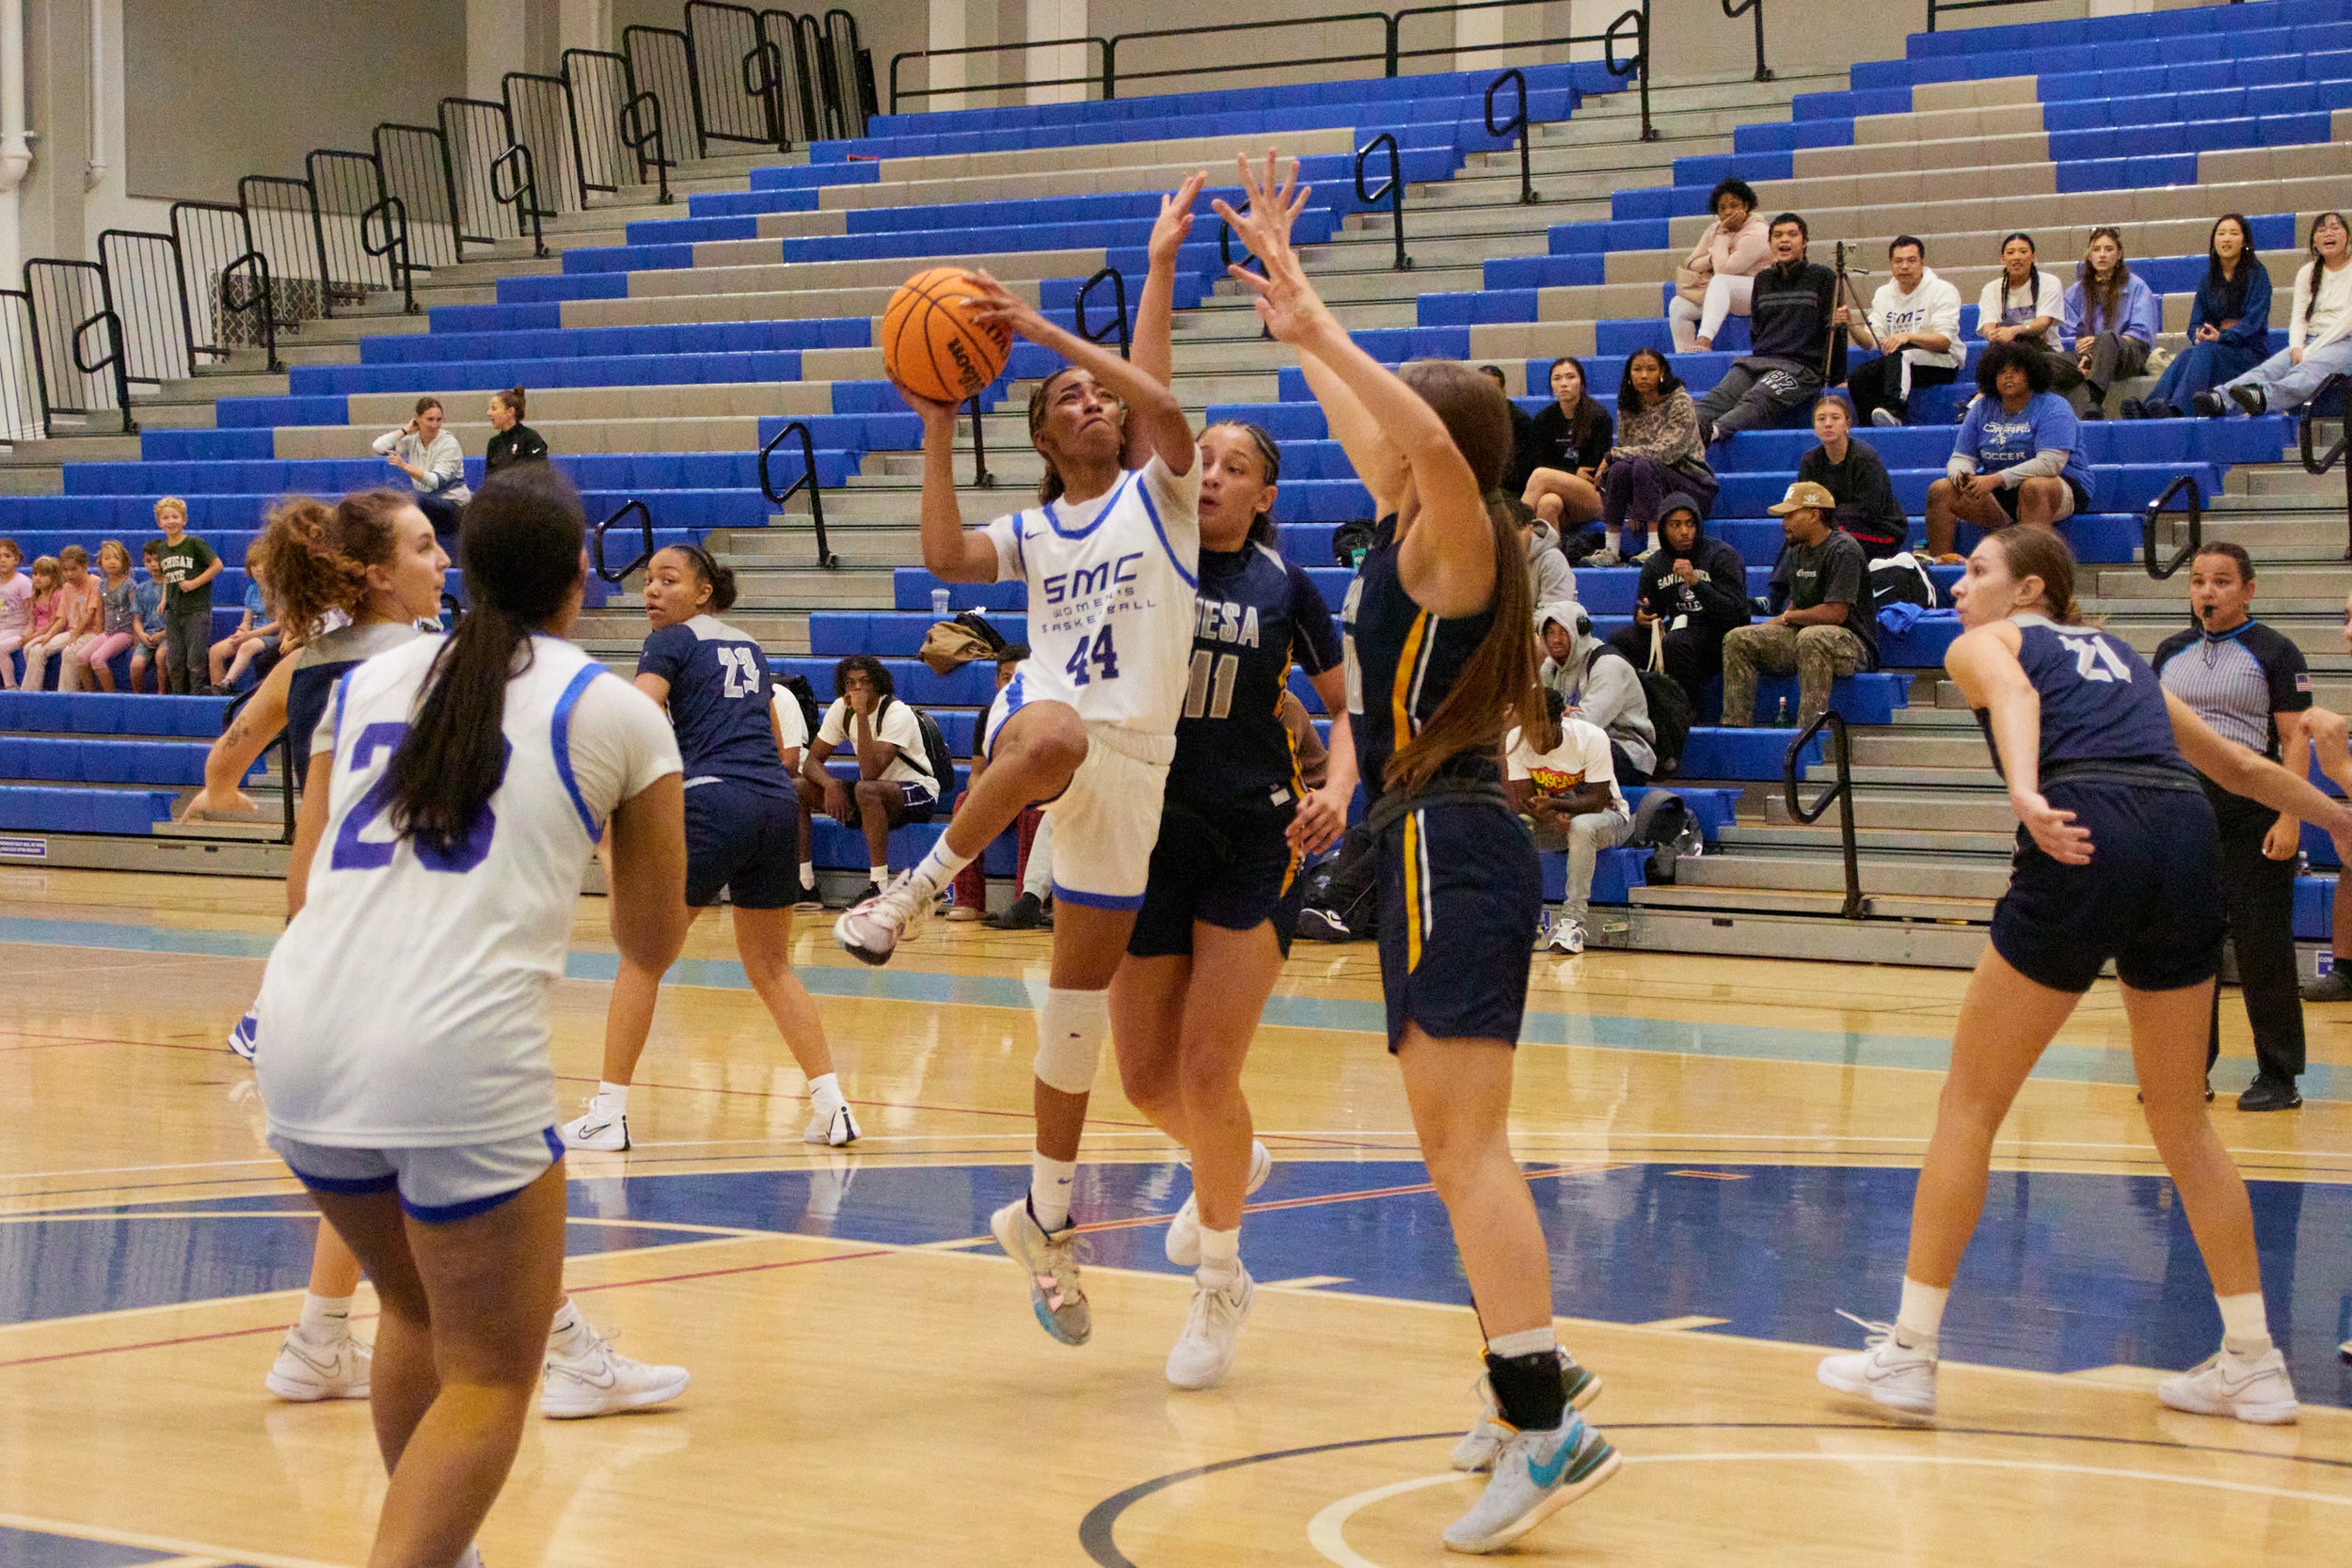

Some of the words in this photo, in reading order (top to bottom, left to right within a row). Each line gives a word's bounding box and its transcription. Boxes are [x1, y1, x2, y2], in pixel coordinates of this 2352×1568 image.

[1043, 551, 1144, 604] SMC
[1041, 599, 1156, 633] ASKEBALL
[717, 646, 760, 698] 23
[1066, 624, 1120, 687] 44
[2058, 635, 2133, 683] 21
[1184, 649, 1240, 719] 11
